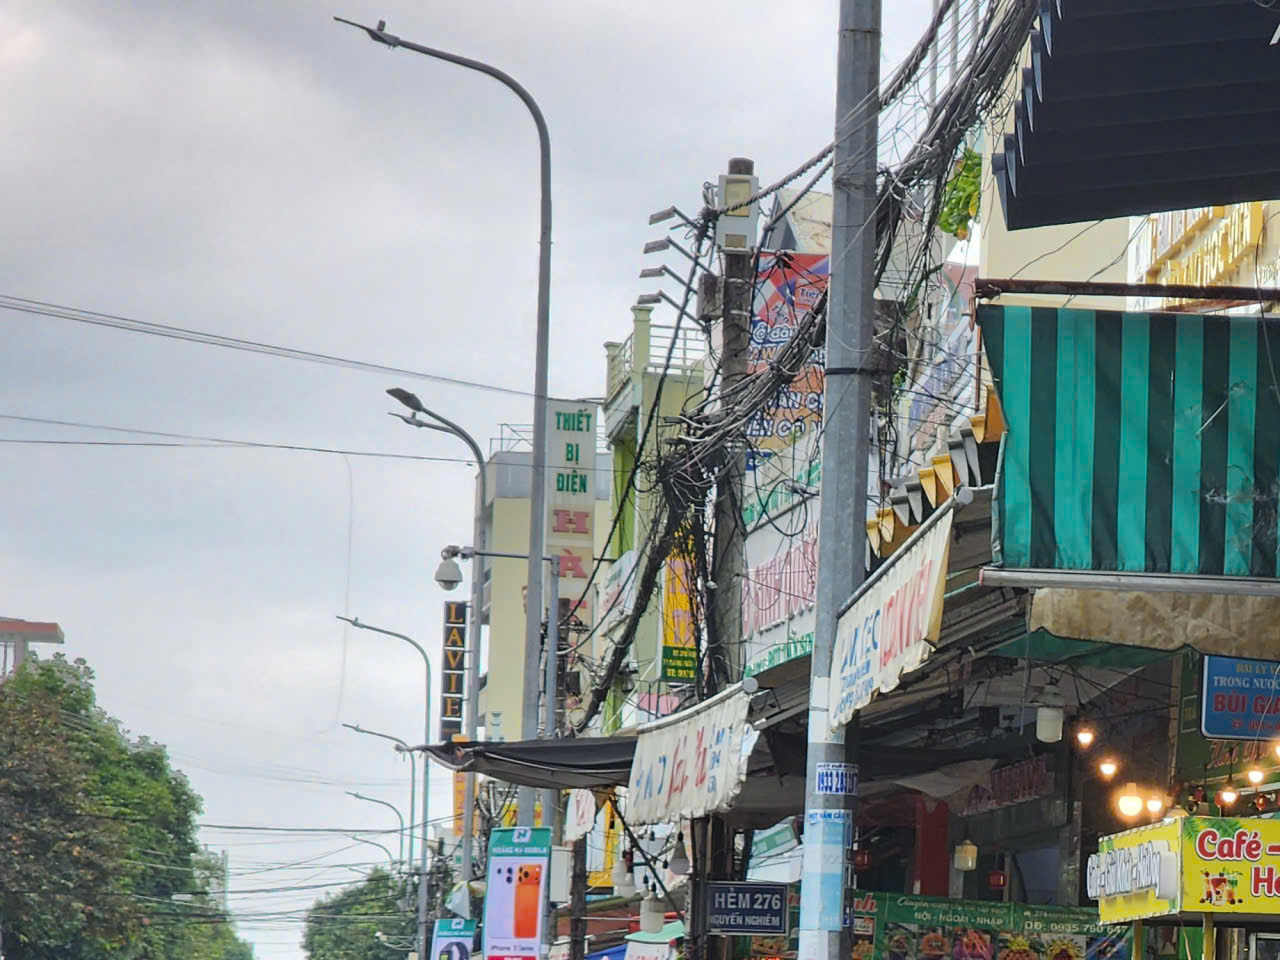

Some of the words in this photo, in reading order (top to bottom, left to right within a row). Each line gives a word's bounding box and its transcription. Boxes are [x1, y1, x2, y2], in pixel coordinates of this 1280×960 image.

[555, 407, 592, 433] THIẾT
[565, 443, 580, 465] BỊ
[556, 470, 588, 496] ĐIỆN
[446, 603, 464, 718] LAVIE
[1213, 676, 1250, 689] TRONG
[1197, 829, 1262, 859] Café
[714, 887, 751, 910] HẺM
[754, 893, 782, 910] 276
[745, 913, 780, 927] NGHIÊM
[1083, 924, 1104, 934] 760
